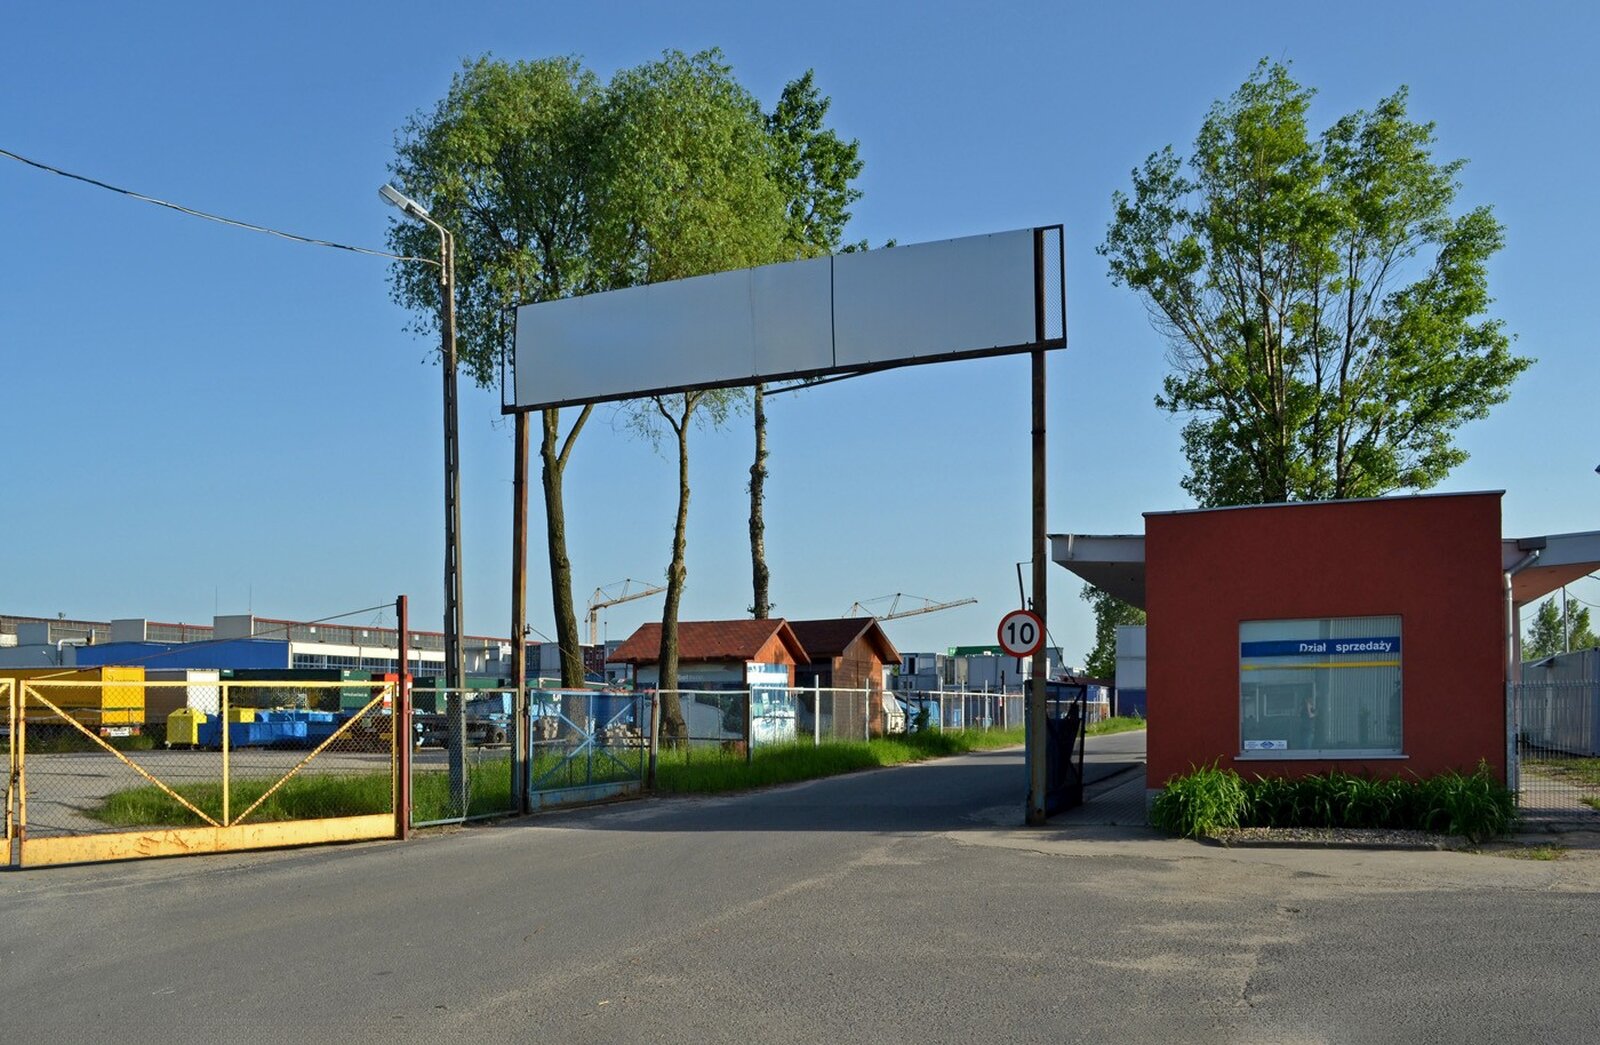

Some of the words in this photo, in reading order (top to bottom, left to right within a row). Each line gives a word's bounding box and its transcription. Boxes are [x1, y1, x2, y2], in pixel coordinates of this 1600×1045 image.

[1007, 622, 1035, 645] 10
[1299, 642, 1327, 653] Dział
[1335, 640, 1392, 654] sprzedaży
